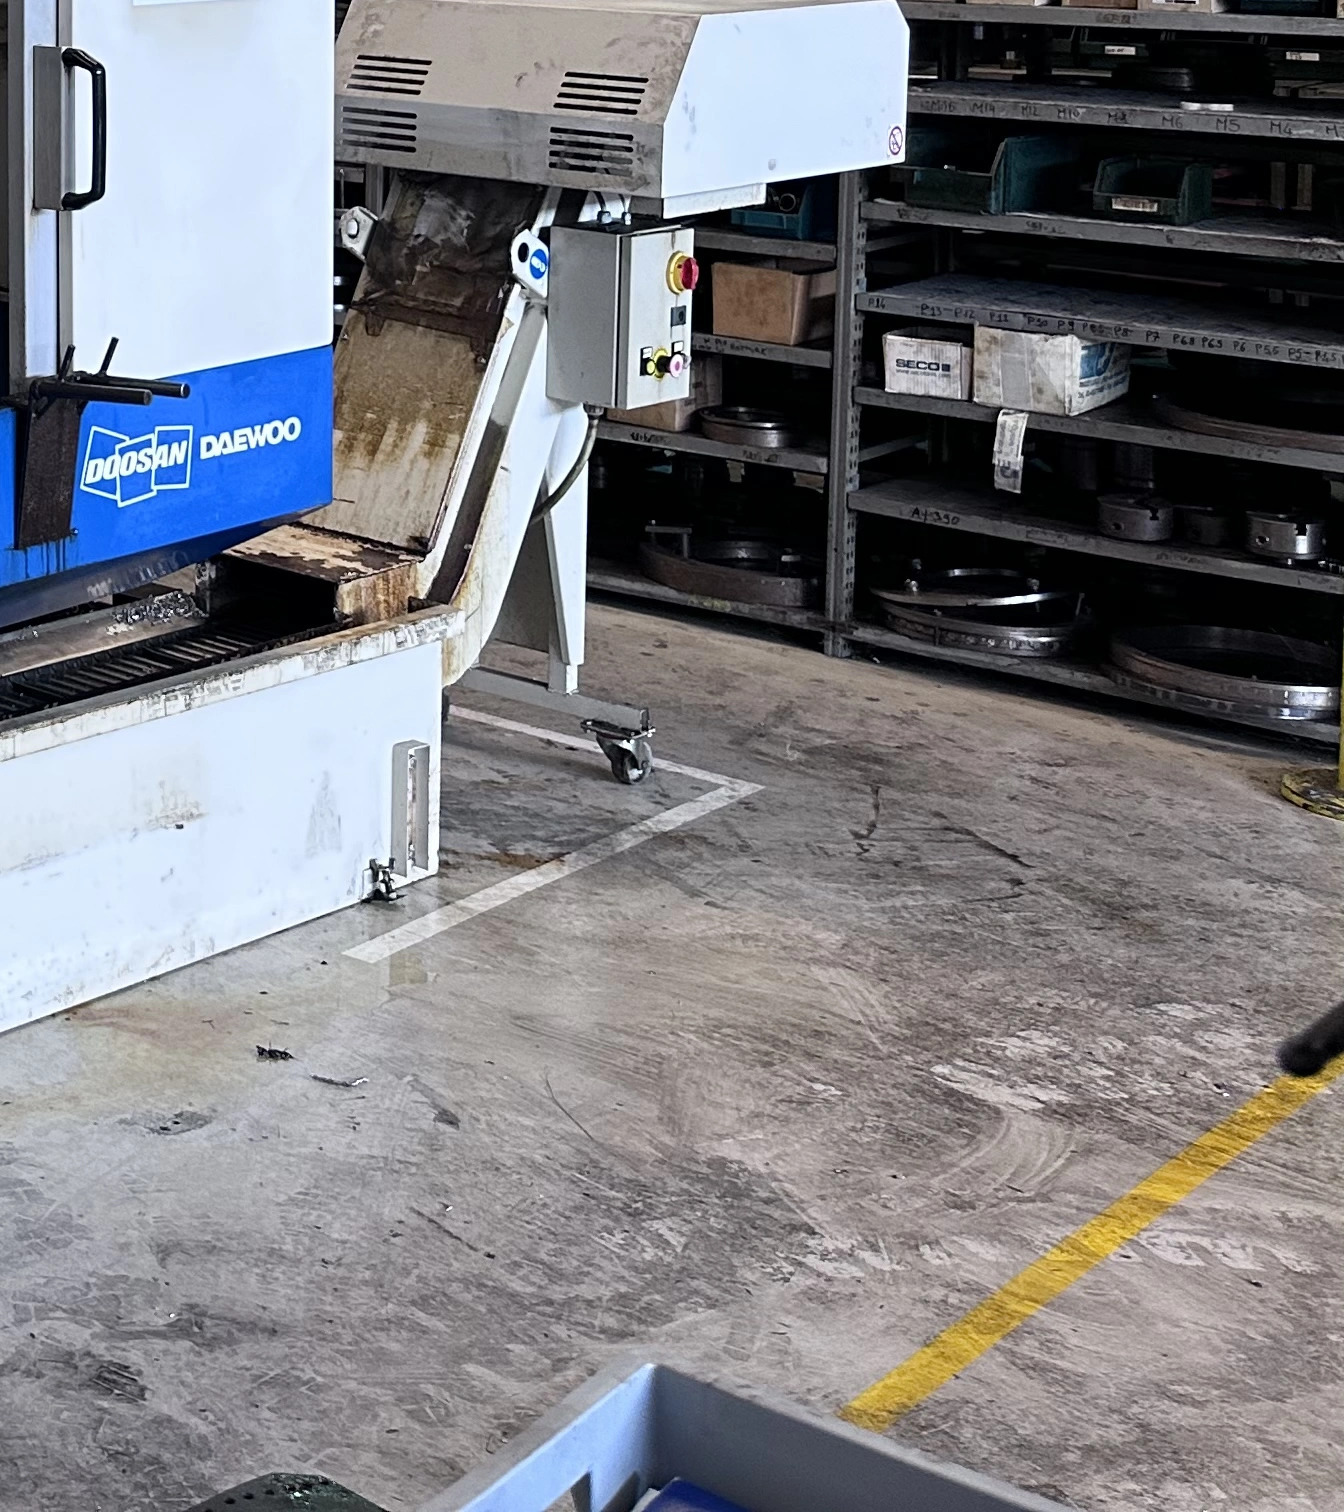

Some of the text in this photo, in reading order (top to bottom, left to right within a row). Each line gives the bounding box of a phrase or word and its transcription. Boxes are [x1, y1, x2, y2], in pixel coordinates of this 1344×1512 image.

[1162, 113, 1184, 129] M6
[1215, 115, 1240, 132] M5
[1269, 120, 1293, 136] M4
[1145, 330, 1160, 343] P7
[895, 358, 940, 372] SECO
[84, 416, 302, 484] DOOSAN DAEWOO
